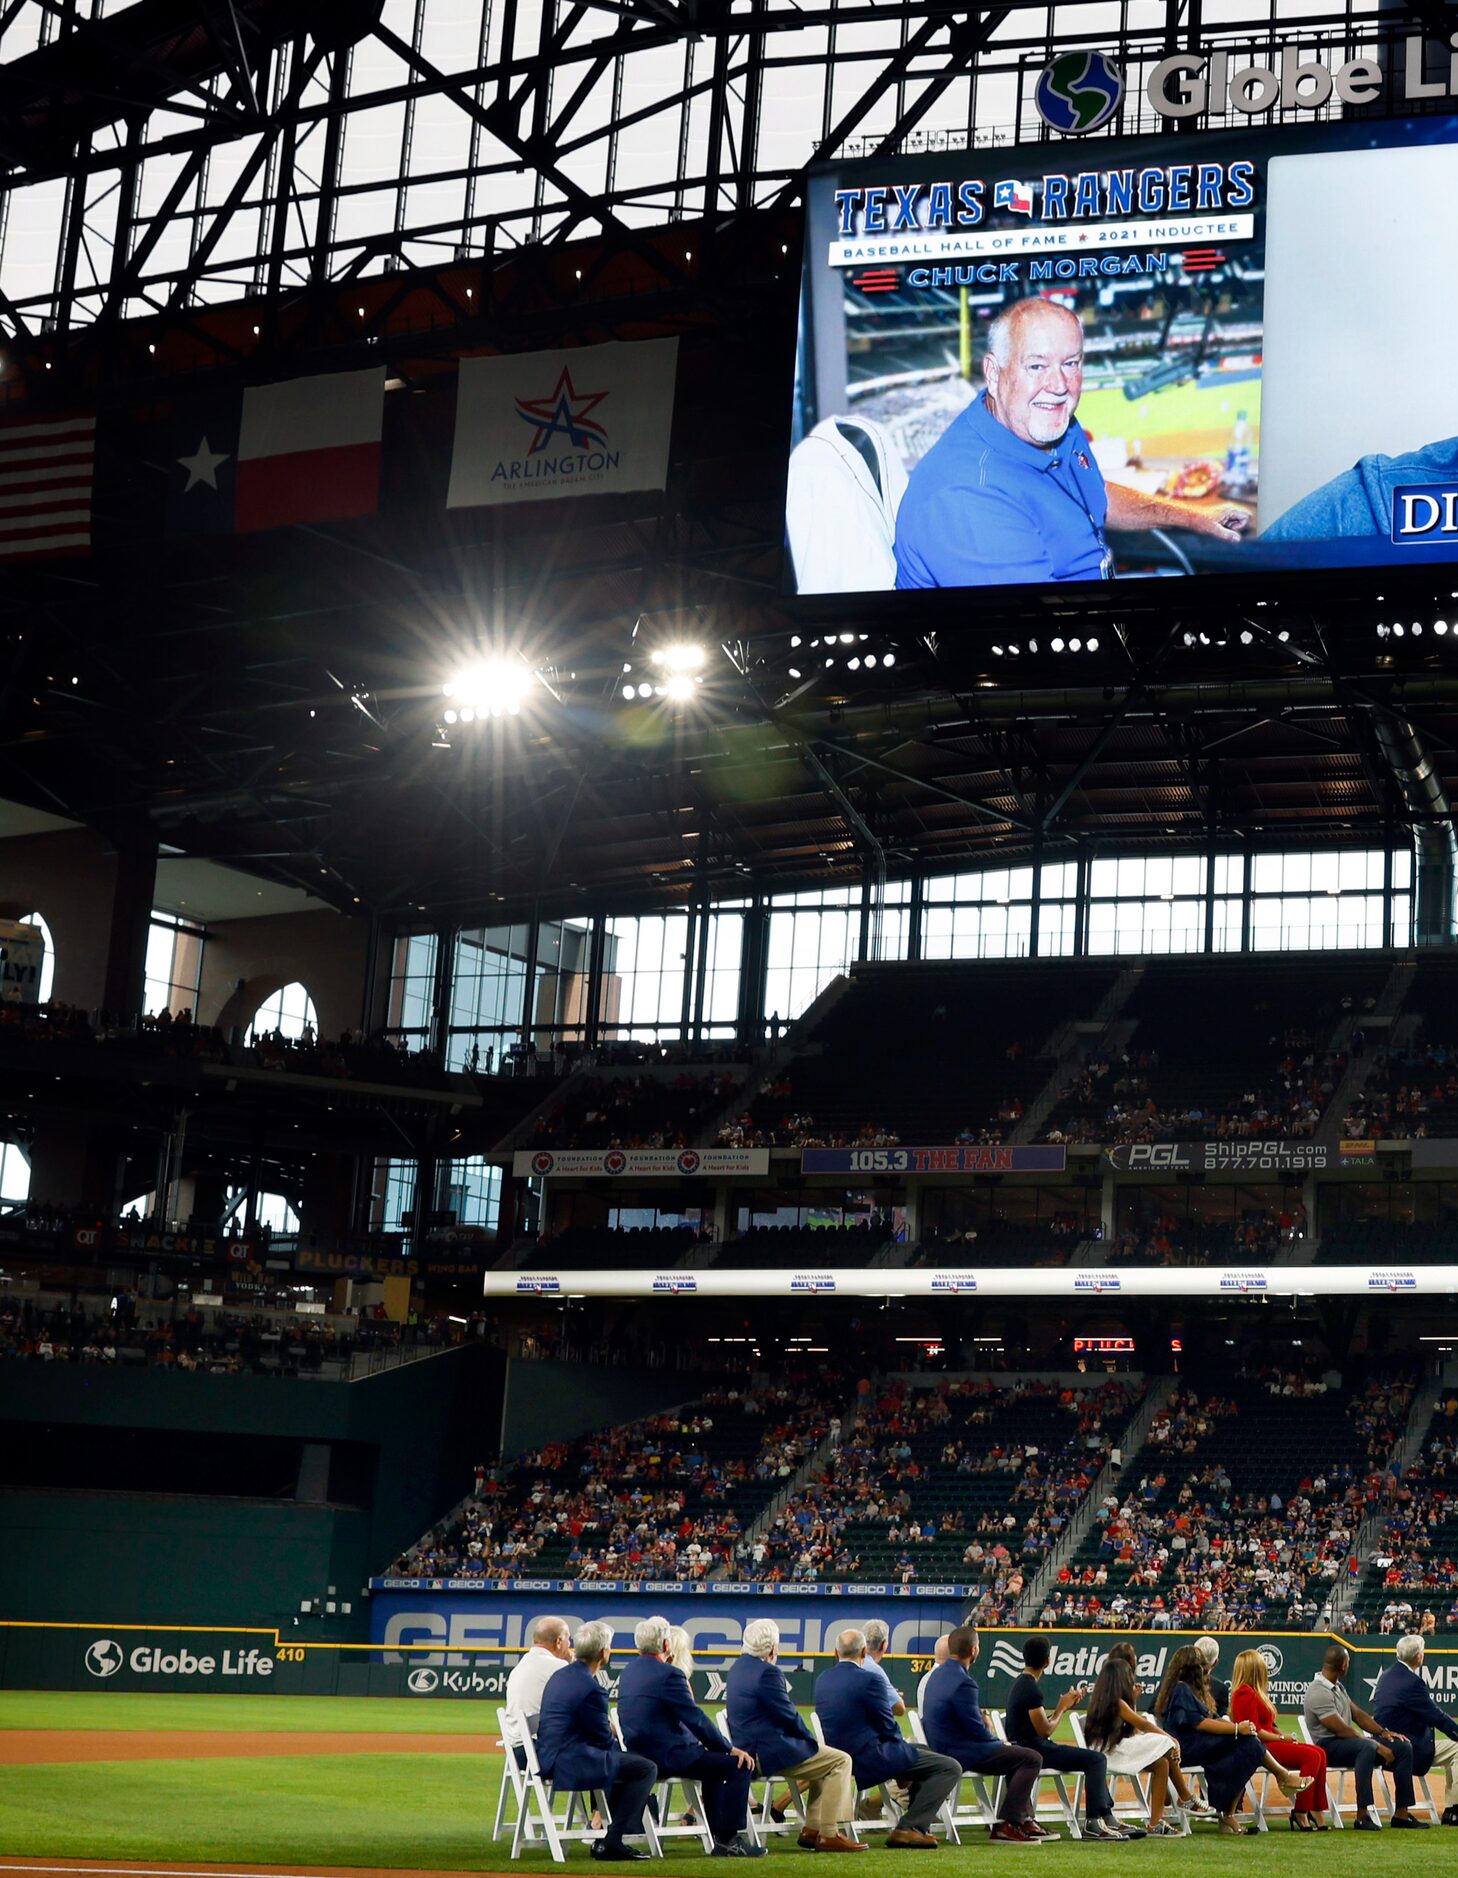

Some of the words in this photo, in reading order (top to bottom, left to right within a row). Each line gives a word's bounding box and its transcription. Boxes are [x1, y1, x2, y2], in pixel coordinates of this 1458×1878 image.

[1147, 46, 1383, 117] Globe
[834, 179, 985, 233] TEXAS
[1041, 161, 1255, 219] RANGERS
[843, 243, 933, 259] BASEBALL
[940, 240, 984, 252] HALL
[992, 238, 1014, 249] OF
[1021, 234, 1067, 245] FAME
[1099, 229, 1138, 240] 2021
[1148, 222, 1238, 239] INDUCTEE
[908, 263, 1019, 289] CHUCK
[1029, 252, 1167, 281] MORGAN
[490, 451, 620, 481] ARLINGTON
[1128, 1143, 1190, 1165] PGL
[1204, 1142, 1327, 1156] ShipPGL.com
[849, 1150, 908, 1171] 105.3
[912, 1149, 959, 1170] THE
[964, 1148, 1013, 1169] FAN
[1204, 1156, 1327, 1169] 877.701.1919
[76, 1230, 97, 1244] QT
[229, 1244, 250, 1258] QT
[298, 1250, 420, 1275] PLUCKERS
[383, 1579, 420, 1588] GEICO
[448, 1579, 485, 1589] GEICO
[513, 1580, 550, 1590] GEICO
[579, 1581, 616, 1590] GEICO
[645, 1583, 682, 1592] GEICO
[712, 1583, 750, 1592] GEICO
[780, 1584, 818, 1593] GEICO
[848, 1585, 886, 1594] GEICO
[916, 1586, 954, 1595] GEICO
[129, 1647, 216, 1675] Globe
[221, 1649, 274, 1676] Life
[276, 1648, 305, 1662] 410
[1043, 1645, 1168, 1677] Natial
[910, 1660, 933, 1672] 374
[443, 1670, 509, 1692] Kubot
[1077, 1680, 1095, 1694] Ca
[1268, 1681, 1310, 1692] MINION
[1429, 1693, 1456, 1703] ROUP
